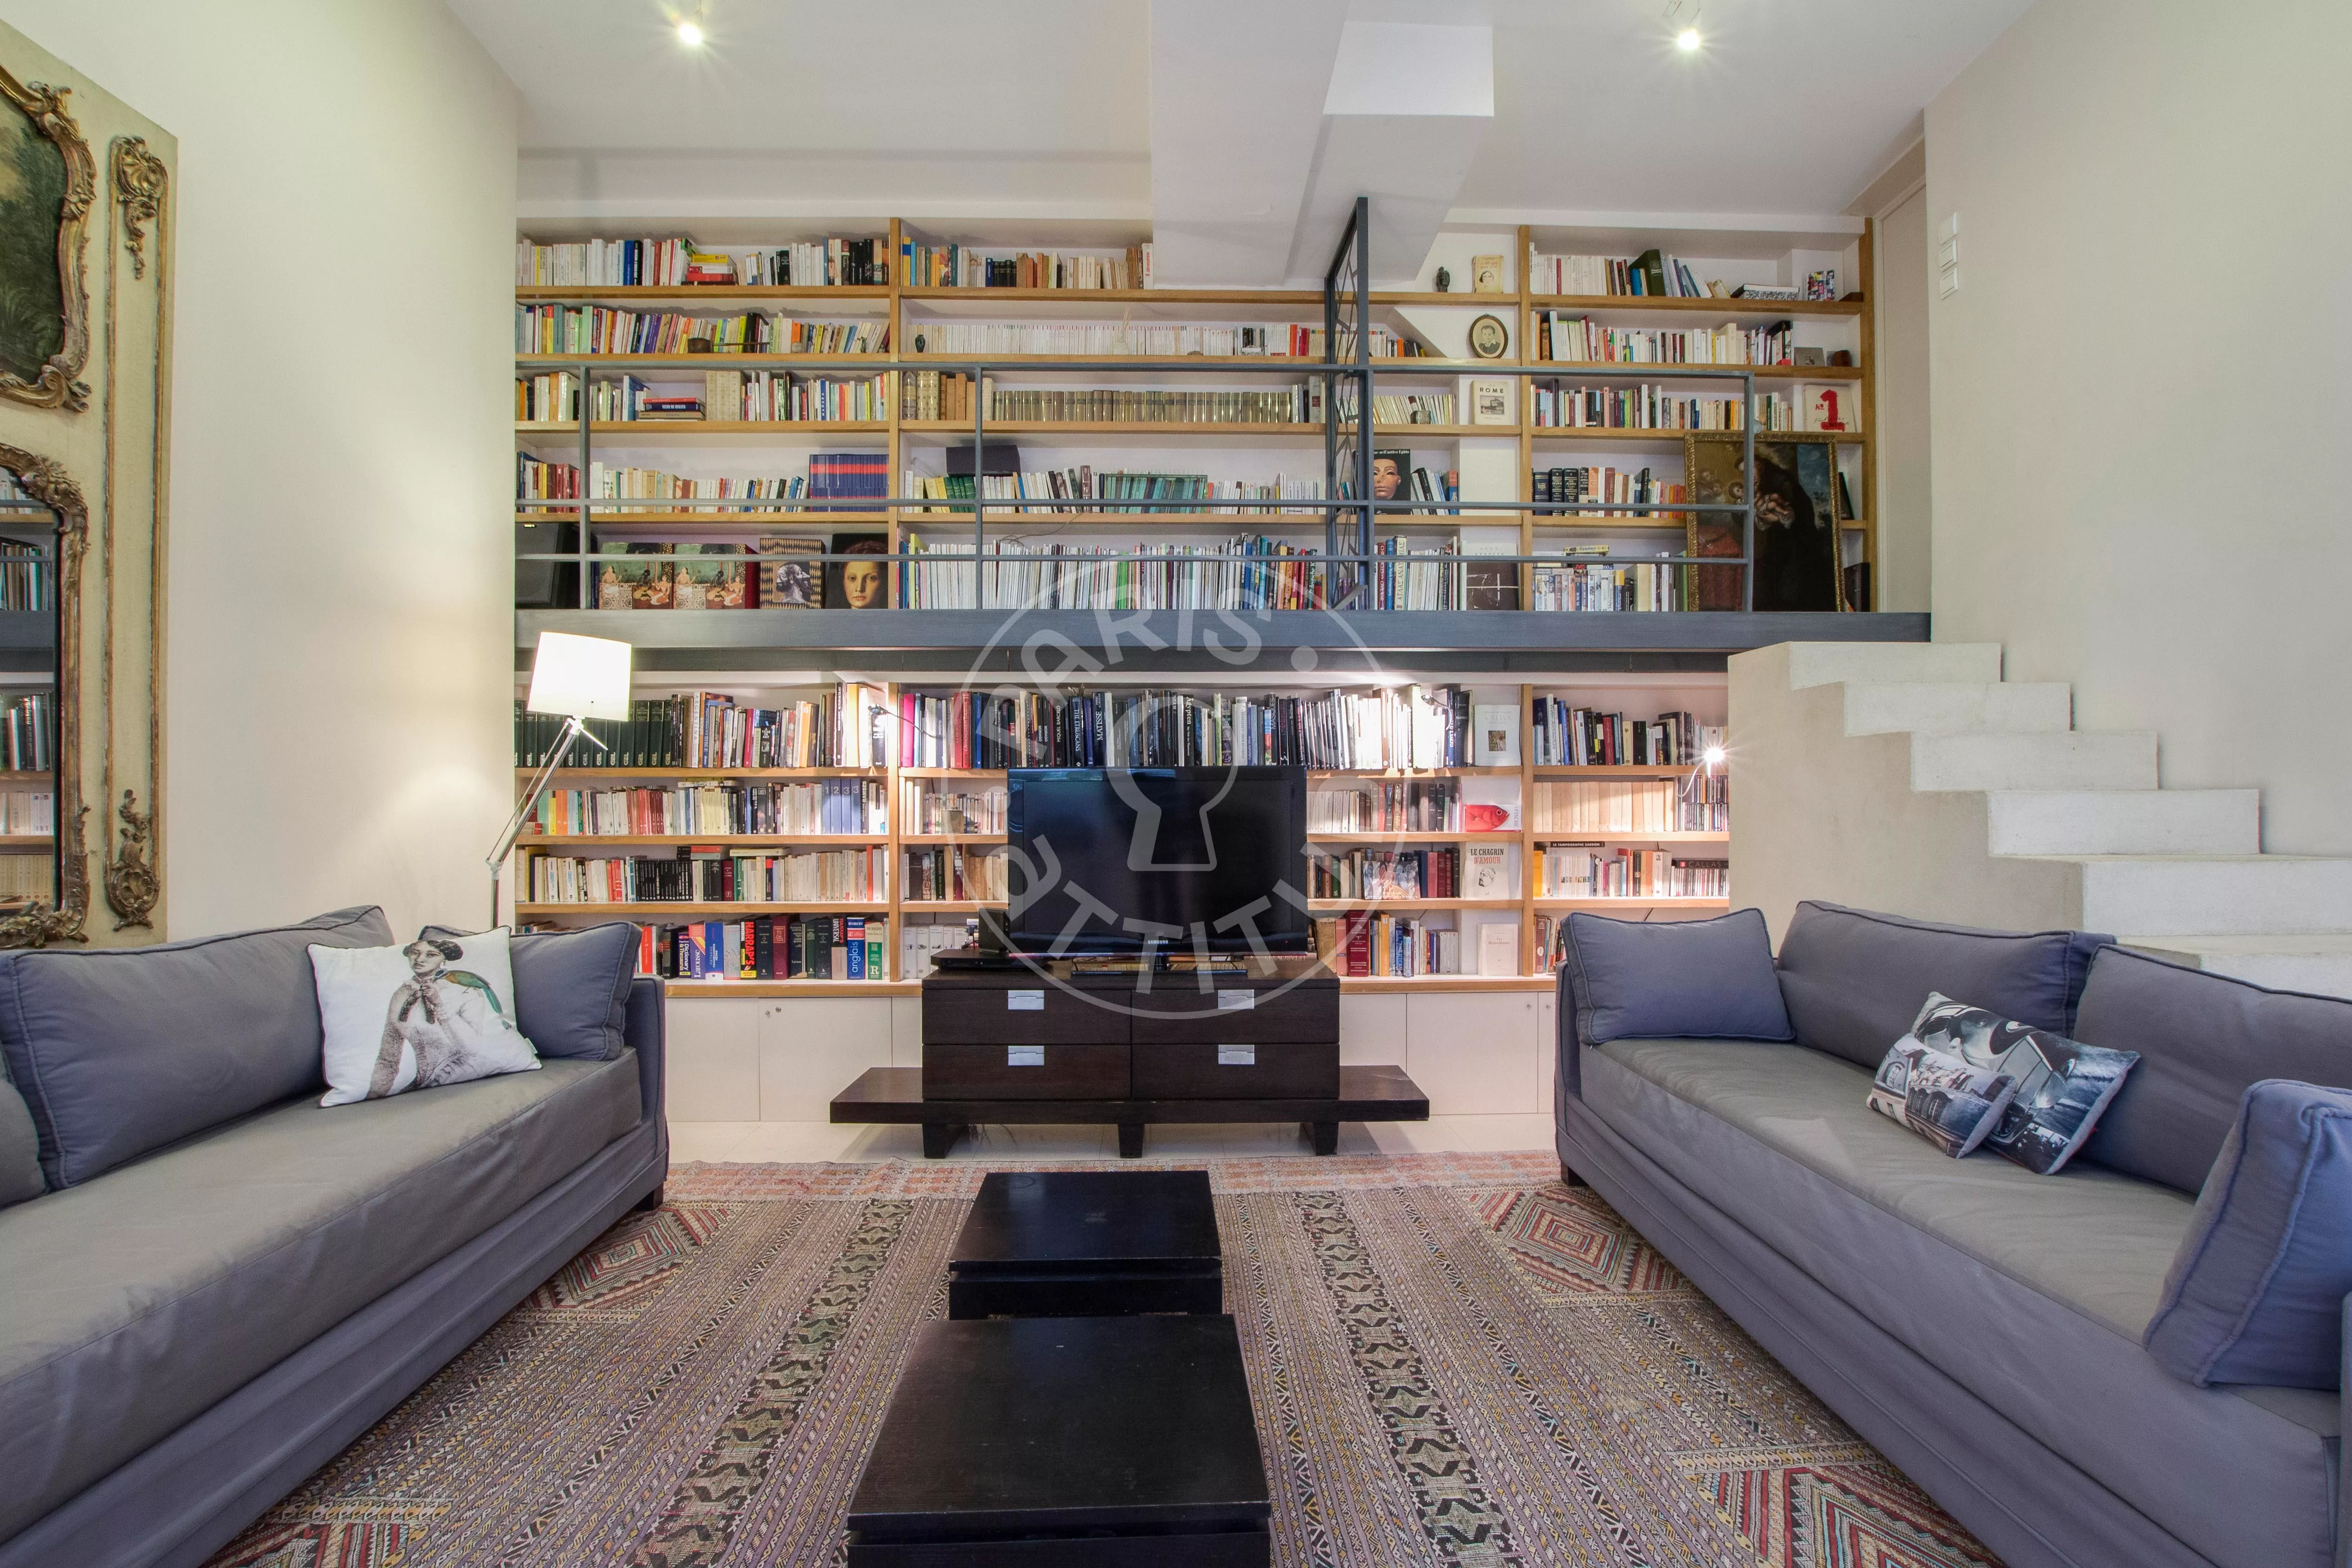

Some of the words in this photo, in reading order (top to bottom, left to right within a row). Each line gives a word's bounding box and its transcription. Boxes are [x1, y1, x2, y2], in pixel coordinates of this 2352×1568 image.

[1397, 541, 1405, 579] ΑΝΑΤΜΙΑΣ
[745, 921, 754, 965] HARRAP'S
[849, 941, 861, 973] anglais
[870, 966, 879, 974] R
